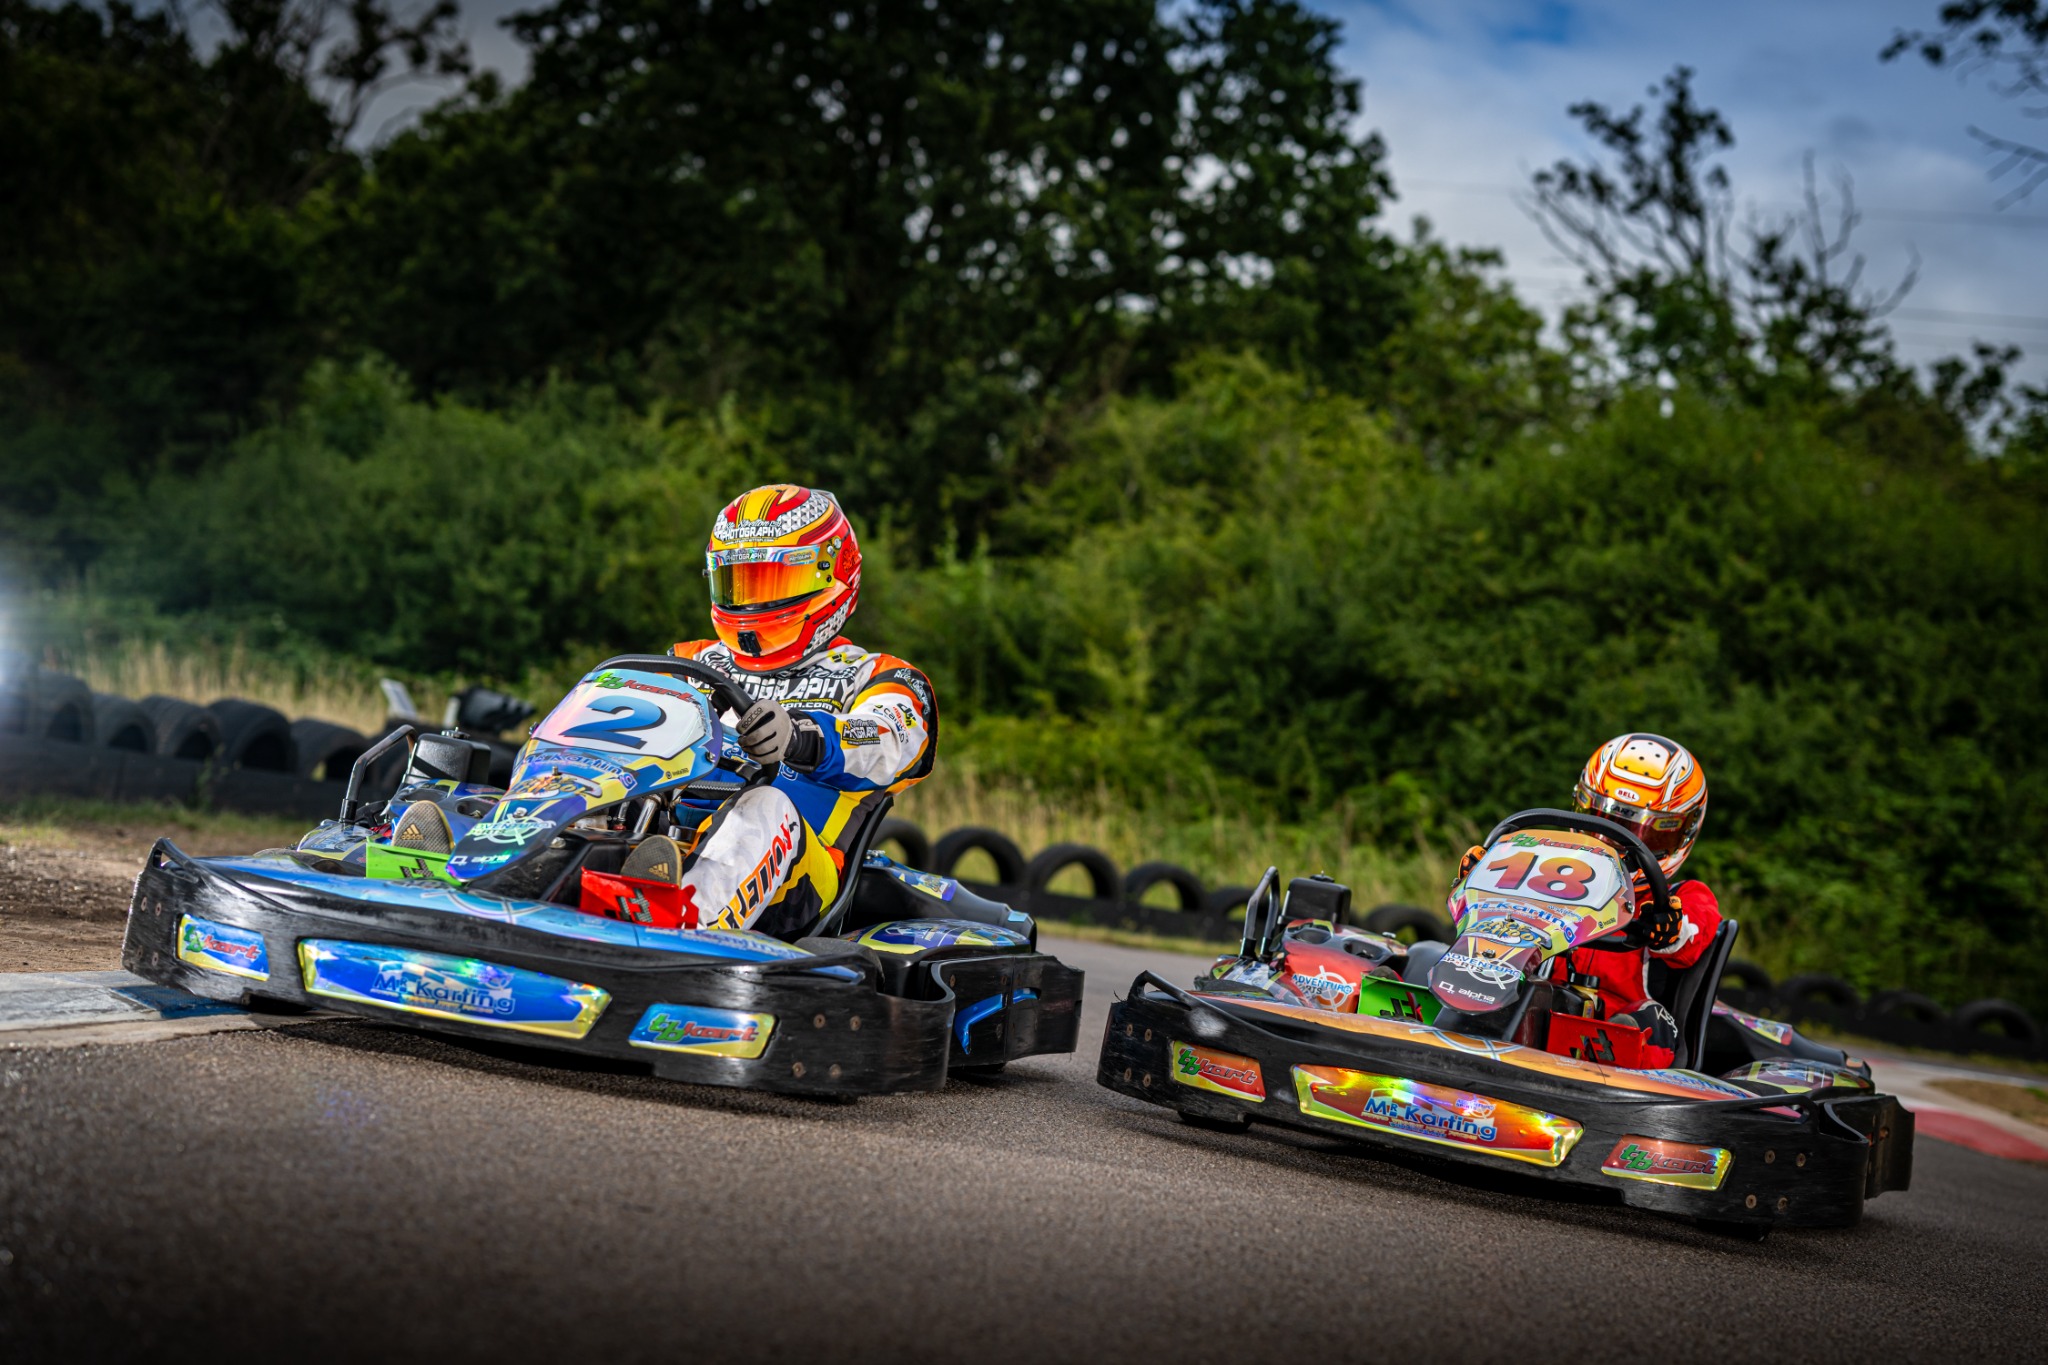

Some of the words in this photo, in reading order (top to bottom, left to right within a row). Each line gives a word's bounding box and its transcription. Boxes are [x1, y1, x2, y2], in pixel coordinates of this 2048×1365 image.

[558, 695, 667, 750] 2
[1617, 789, 1636, 800] BELL
[1486, 851, 1597, 901] 18
[415, 980, 516, 1015] Karting
[1458, 987, 1496, 1002] alpha
[1404, 1105, 1498, 1141] Karting
